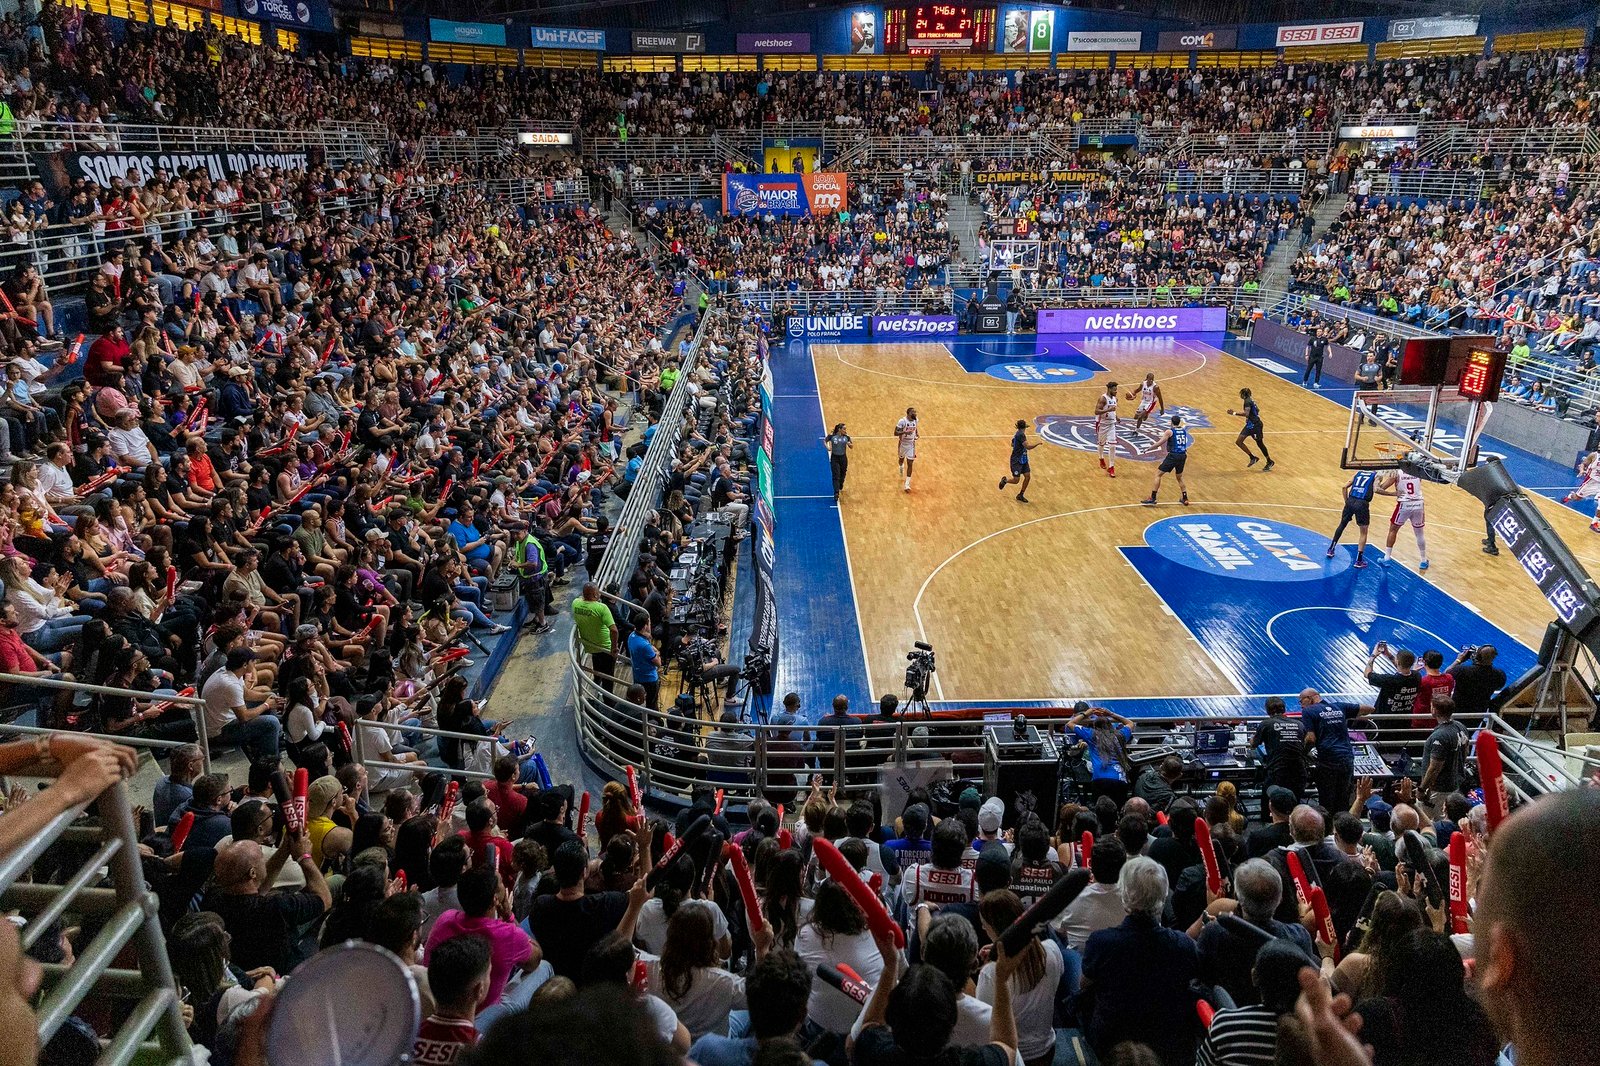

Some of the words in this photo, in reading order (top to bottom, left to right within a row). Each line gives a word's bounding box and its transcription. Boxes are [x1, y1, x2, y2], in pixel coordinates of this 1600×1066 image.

[536, 29, 602, 44] Uni-FACEF
[1037, 23, 1047, 38] 8
[1283, 31, 1313, 41] SESI
[1323, 28, 1355, 39] SESI
[637, 36, 676, 46] FREEWAY
[814, 175, 836, 183] LOJA
[760, 190, 798, 200] MAIOR
[768, 199, 800, 209] BRASIL
[807, 316, 863, 331] UNIUBE
[878, 318, 956, 333] netshoes
[1085, 313, 1178, 330] netshoes
[1356, 476, 1370, 487] 17
[1406, 482, 1414, 494] 9
[1178, 524, 1254, 570] BRASIL
[1237, 522, 1322, 572] CAIXA
[282, 804, 299, 830] SESI
[660, 839, 682, 866] SESI
[931, 872, 959, 884] SESI
[1024, 868, 1049, 877] SESI
[1450, 868, 1460, 898] SESI
[414, 1041, 458, 1062] SESI
